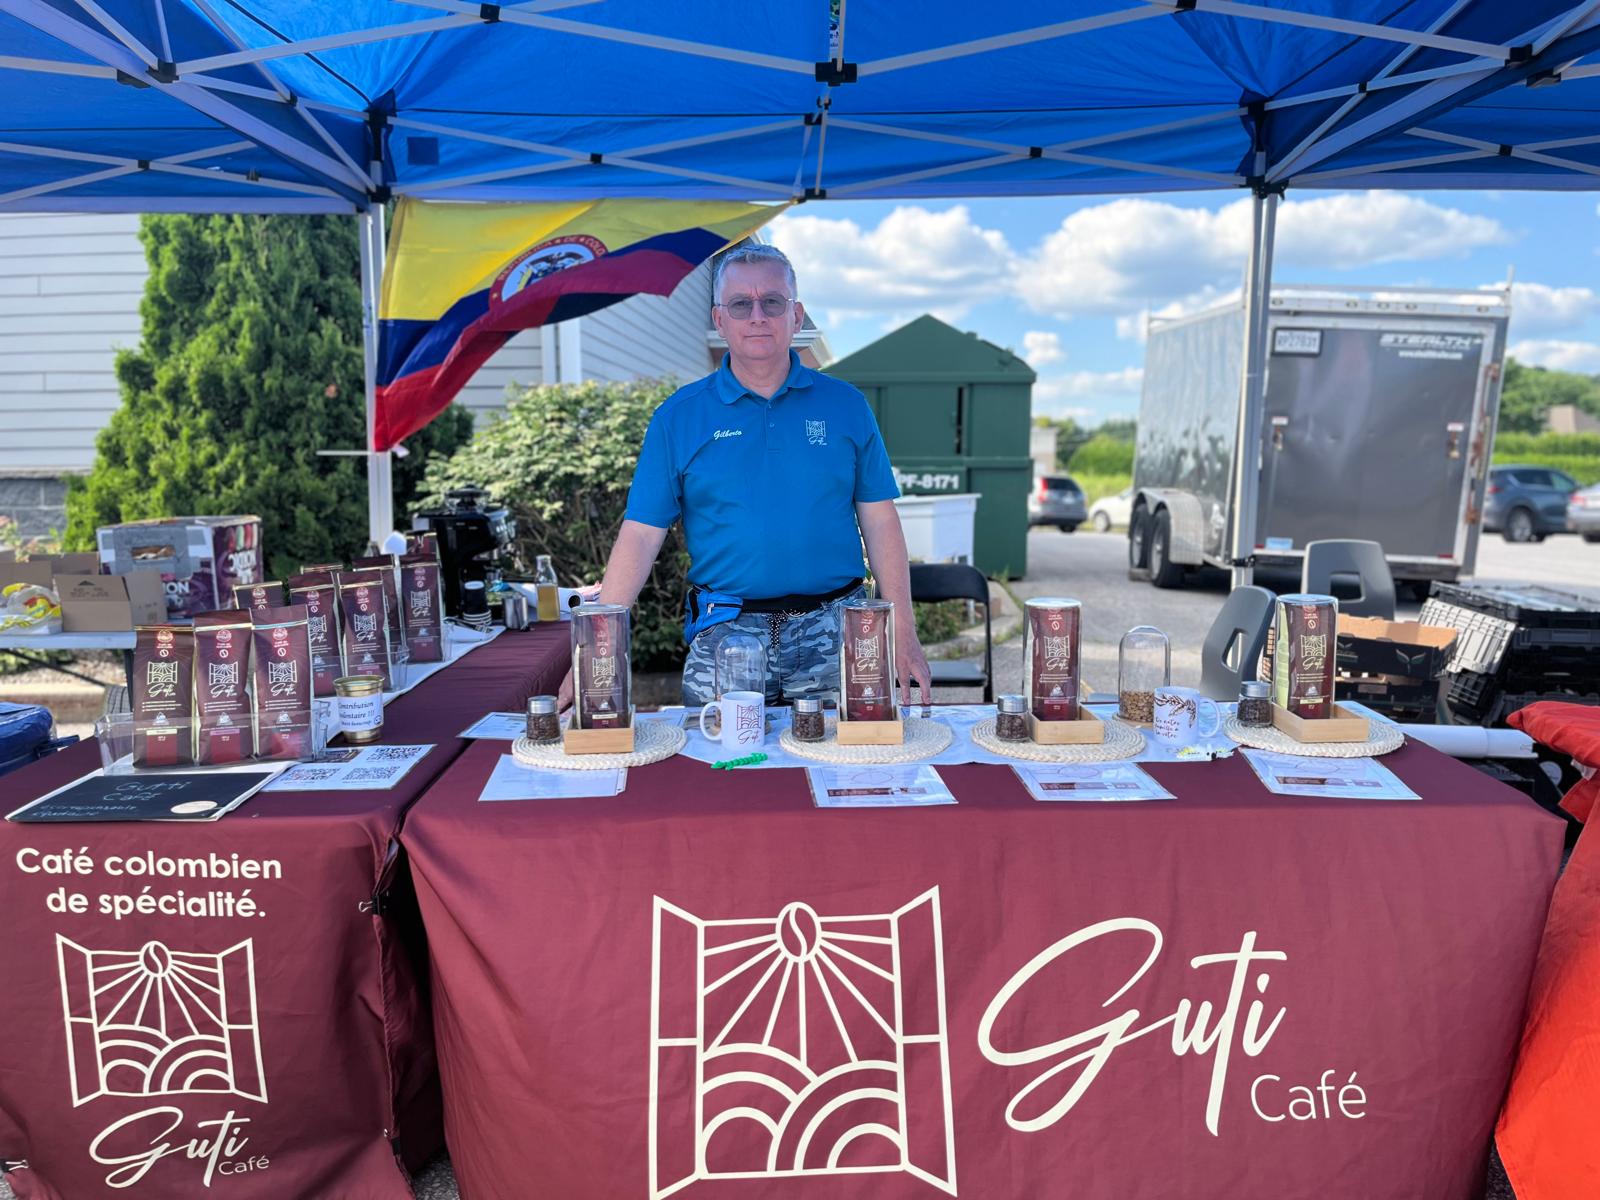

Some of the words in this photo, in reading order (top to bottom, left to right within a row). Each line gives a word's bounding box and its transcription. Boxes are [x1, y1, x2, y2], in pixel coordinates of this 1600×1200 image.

[713, 429, 742, 441] Gilberto
[16, 847, 94, 875] Café
[104, 850, 282, 879] colombien
[46, 887, 89, 914] de
[99, 886, 266, 920] spécialité.
[978, 917, 1288, 1137] Guti
[1251, 1070, 1367, 1122] Café
[89, 1105, 251, 1188] Guti
[218, 1156, 270, 1175] Café
